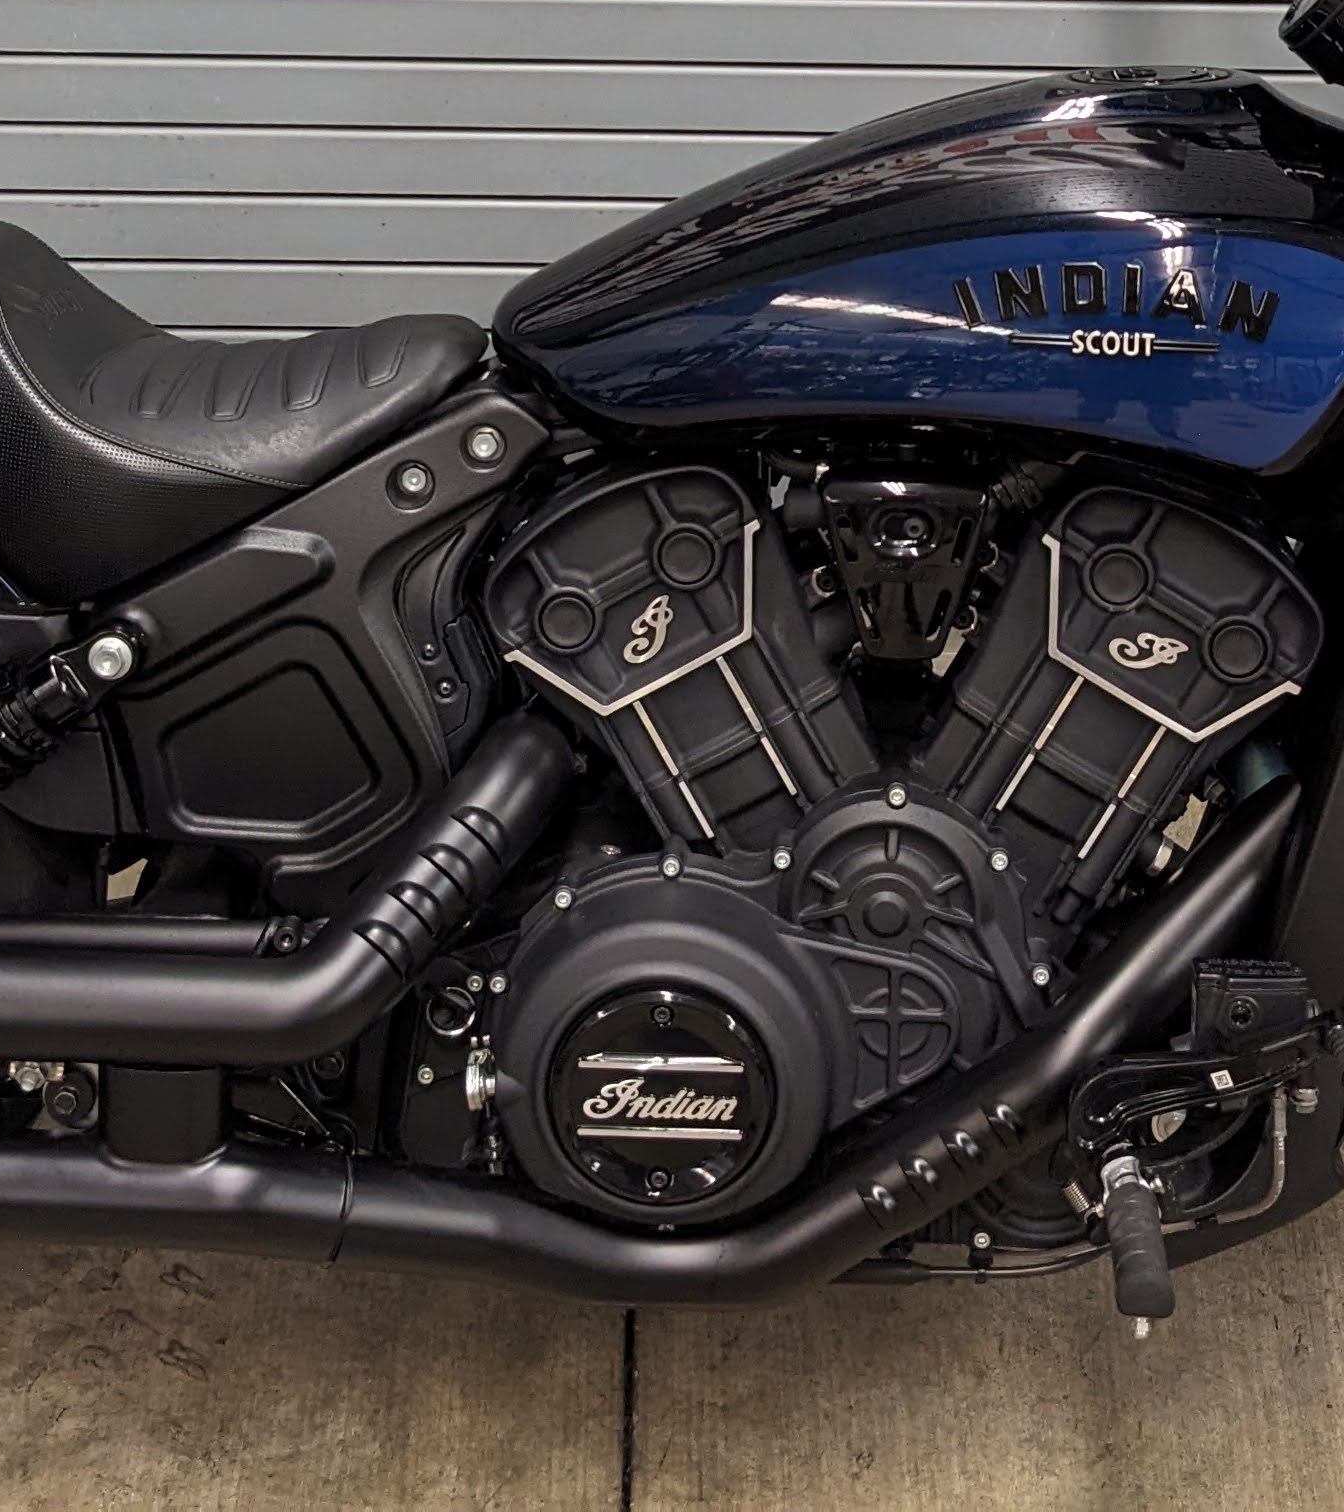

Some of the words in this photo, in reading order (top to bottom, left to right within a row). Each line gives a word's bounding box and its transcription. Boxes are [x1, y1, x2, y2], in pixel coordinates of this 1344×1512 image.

[953, 261, 1280, 342] INDIAN
[1071, 329, 1156, 356] SCOUT
[582, 1077, 738, 1121] Indian
